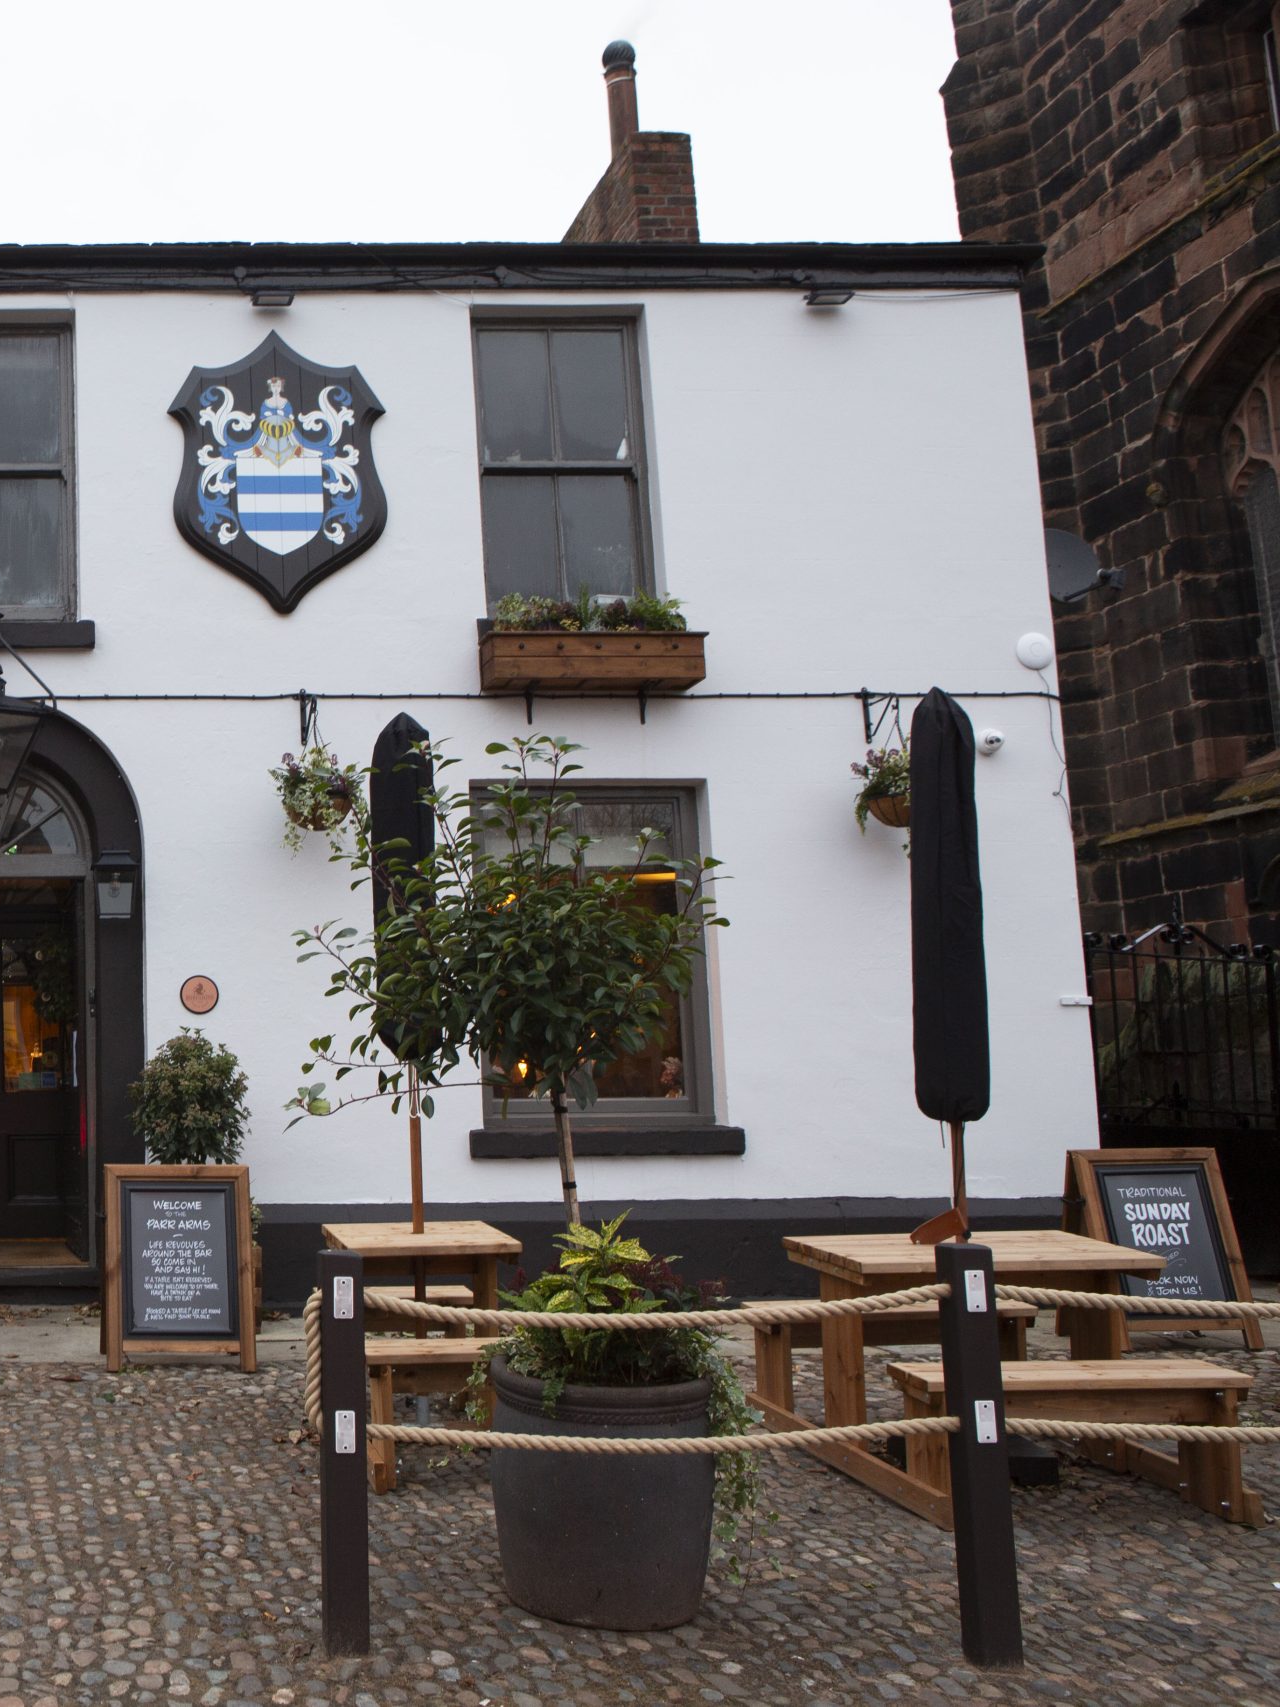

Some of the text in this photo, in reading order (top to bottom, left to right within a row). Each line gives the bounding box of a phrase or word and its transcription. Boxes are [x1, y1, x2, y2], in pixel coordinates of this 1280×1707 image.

[1116, 1186, 1187, 1199] TRADITIONAL
[153, 1200, 202, 1210] WELCOME
[1124, 1202, 1191, 1221] SUNDAY
[147, 1219, 211, 1230] PARR ARMS
[1131, 1222, 1190, 1247] ROAST
[149, 1240, 206, 1249] LIFE REVOLVES
[142, 1248, 213, 1258] AROUND THE BAR
[151, 1258, 196, 1266] SO COME IN
[154, 1266, 173, 1274] AND
[174, 1266, 191, 1274] SAY
[1174, 1275, 1198, 1285] NOW
[1147, 1287, 1154, 1296] &
[1156, 1287, 1180, 1296] JOIN
